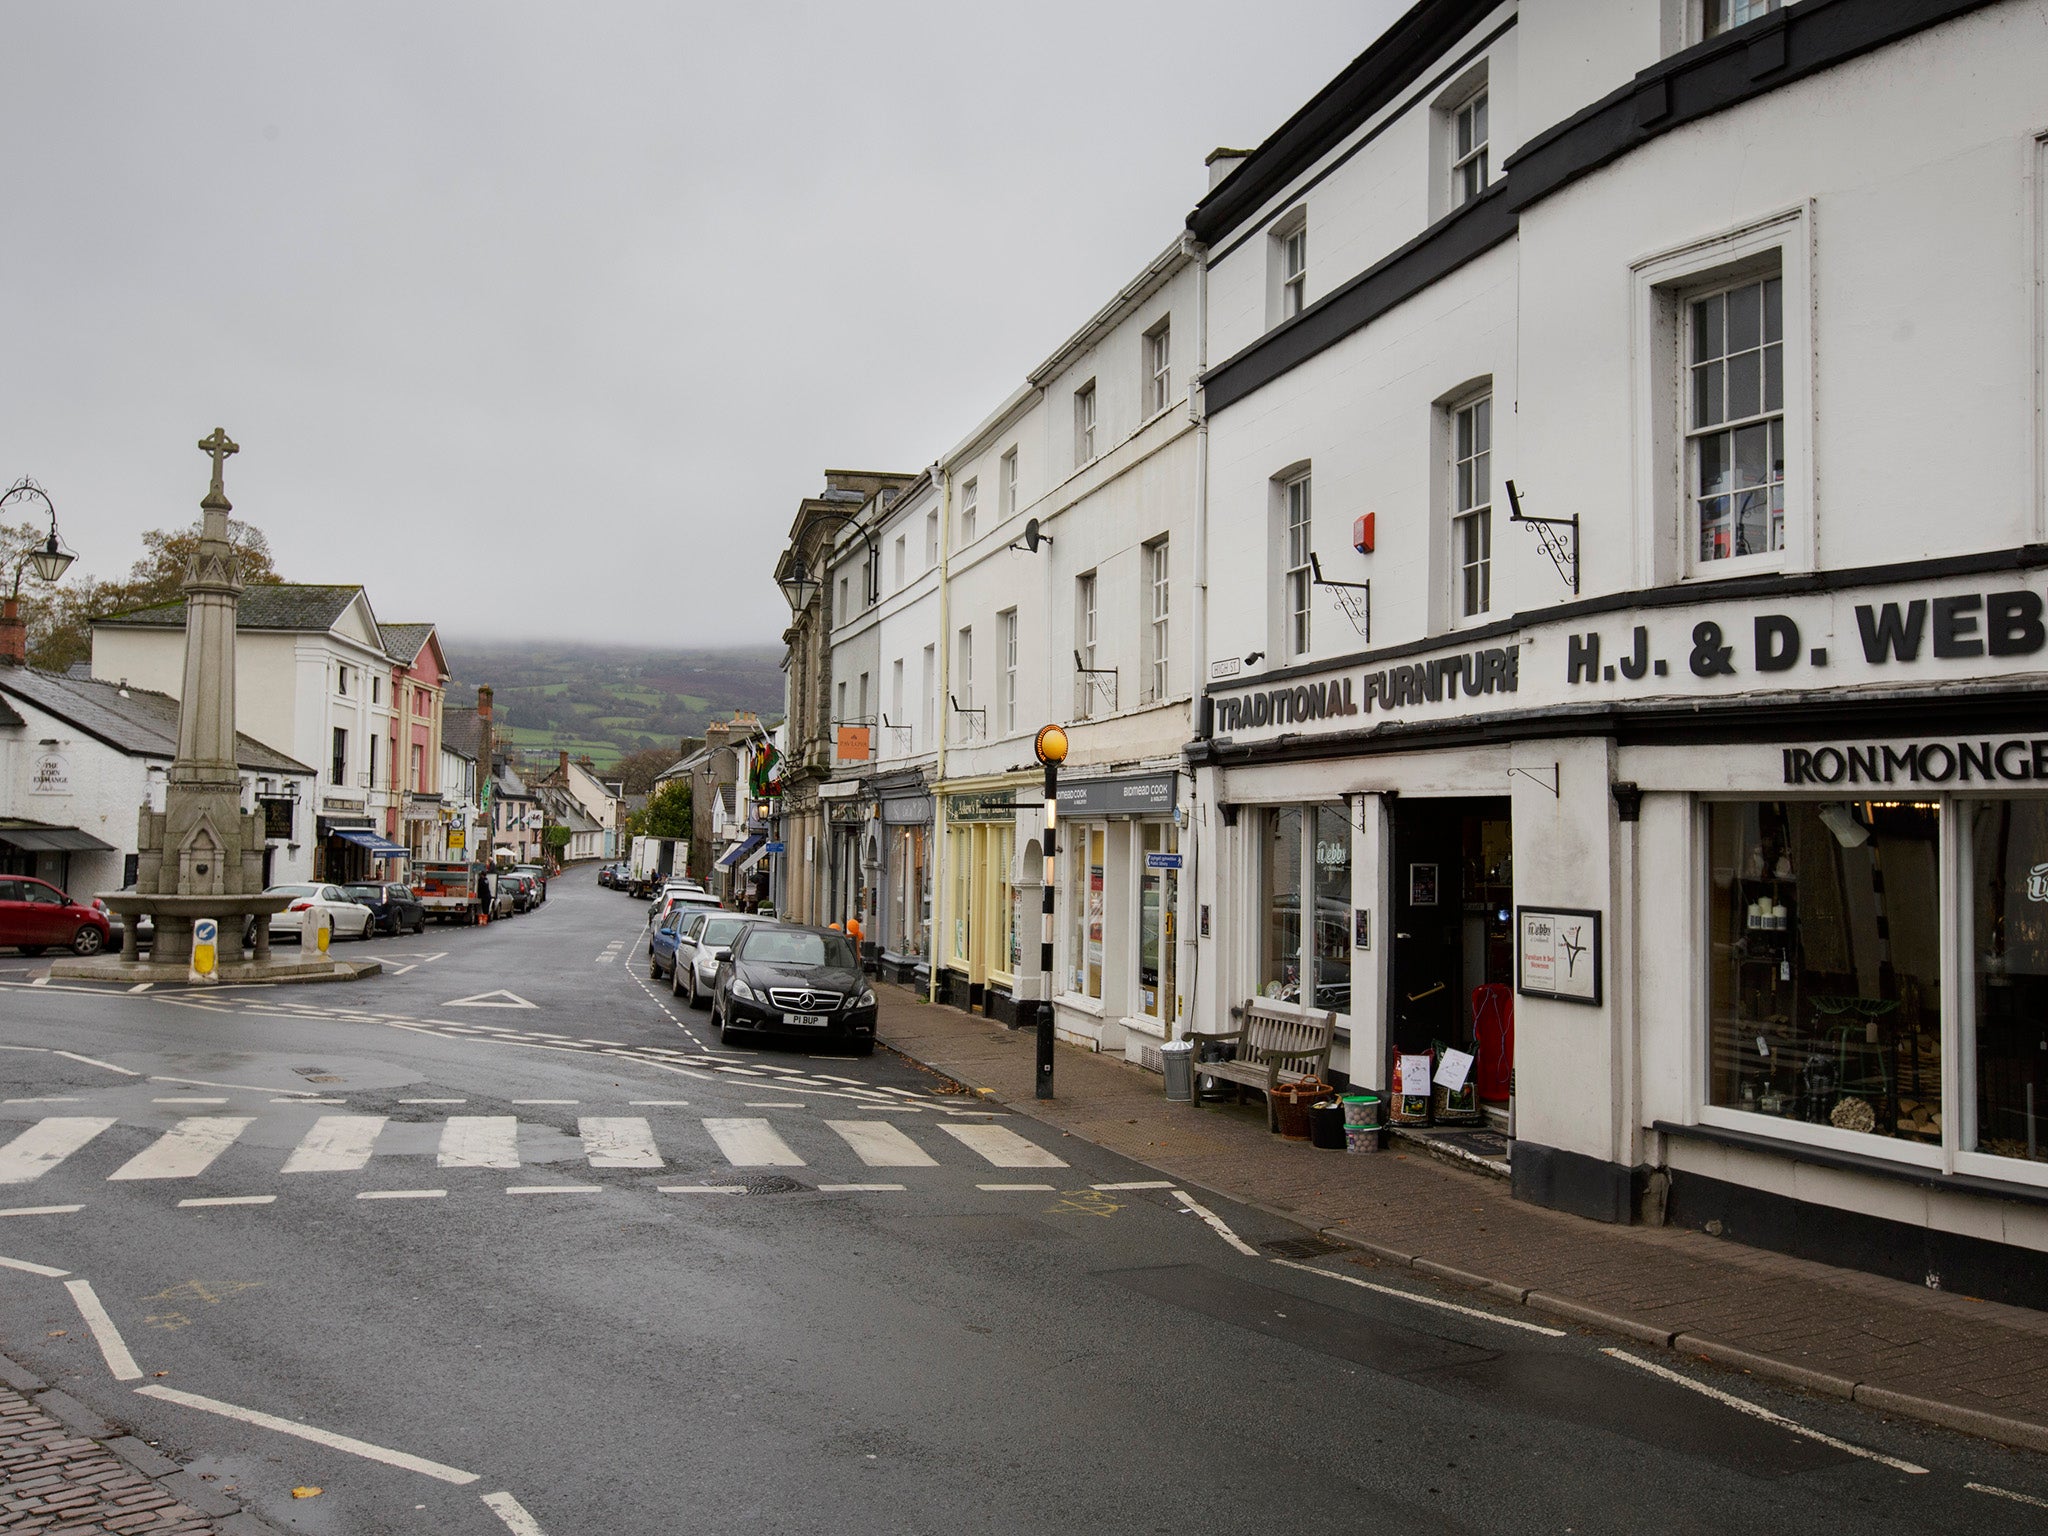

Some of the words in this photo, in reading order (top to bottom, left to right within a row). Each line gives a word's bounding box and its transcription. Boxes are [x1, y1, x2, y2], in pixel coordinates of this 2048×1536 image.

[1567, 625, 1668, 684] H.J.
[1689, 621, 1737, 678] &
[1214, 663, 1228, 675] HIGH
[1216, 677, 1357, 732] TRADITIONAL
[1364, 645, 1520, 713] FURNITURE
[1074, 789, 1088, 799] COOK
[1151, 784, 1168, 794] COOK
[803, 1016, 819, 1024] BUP
